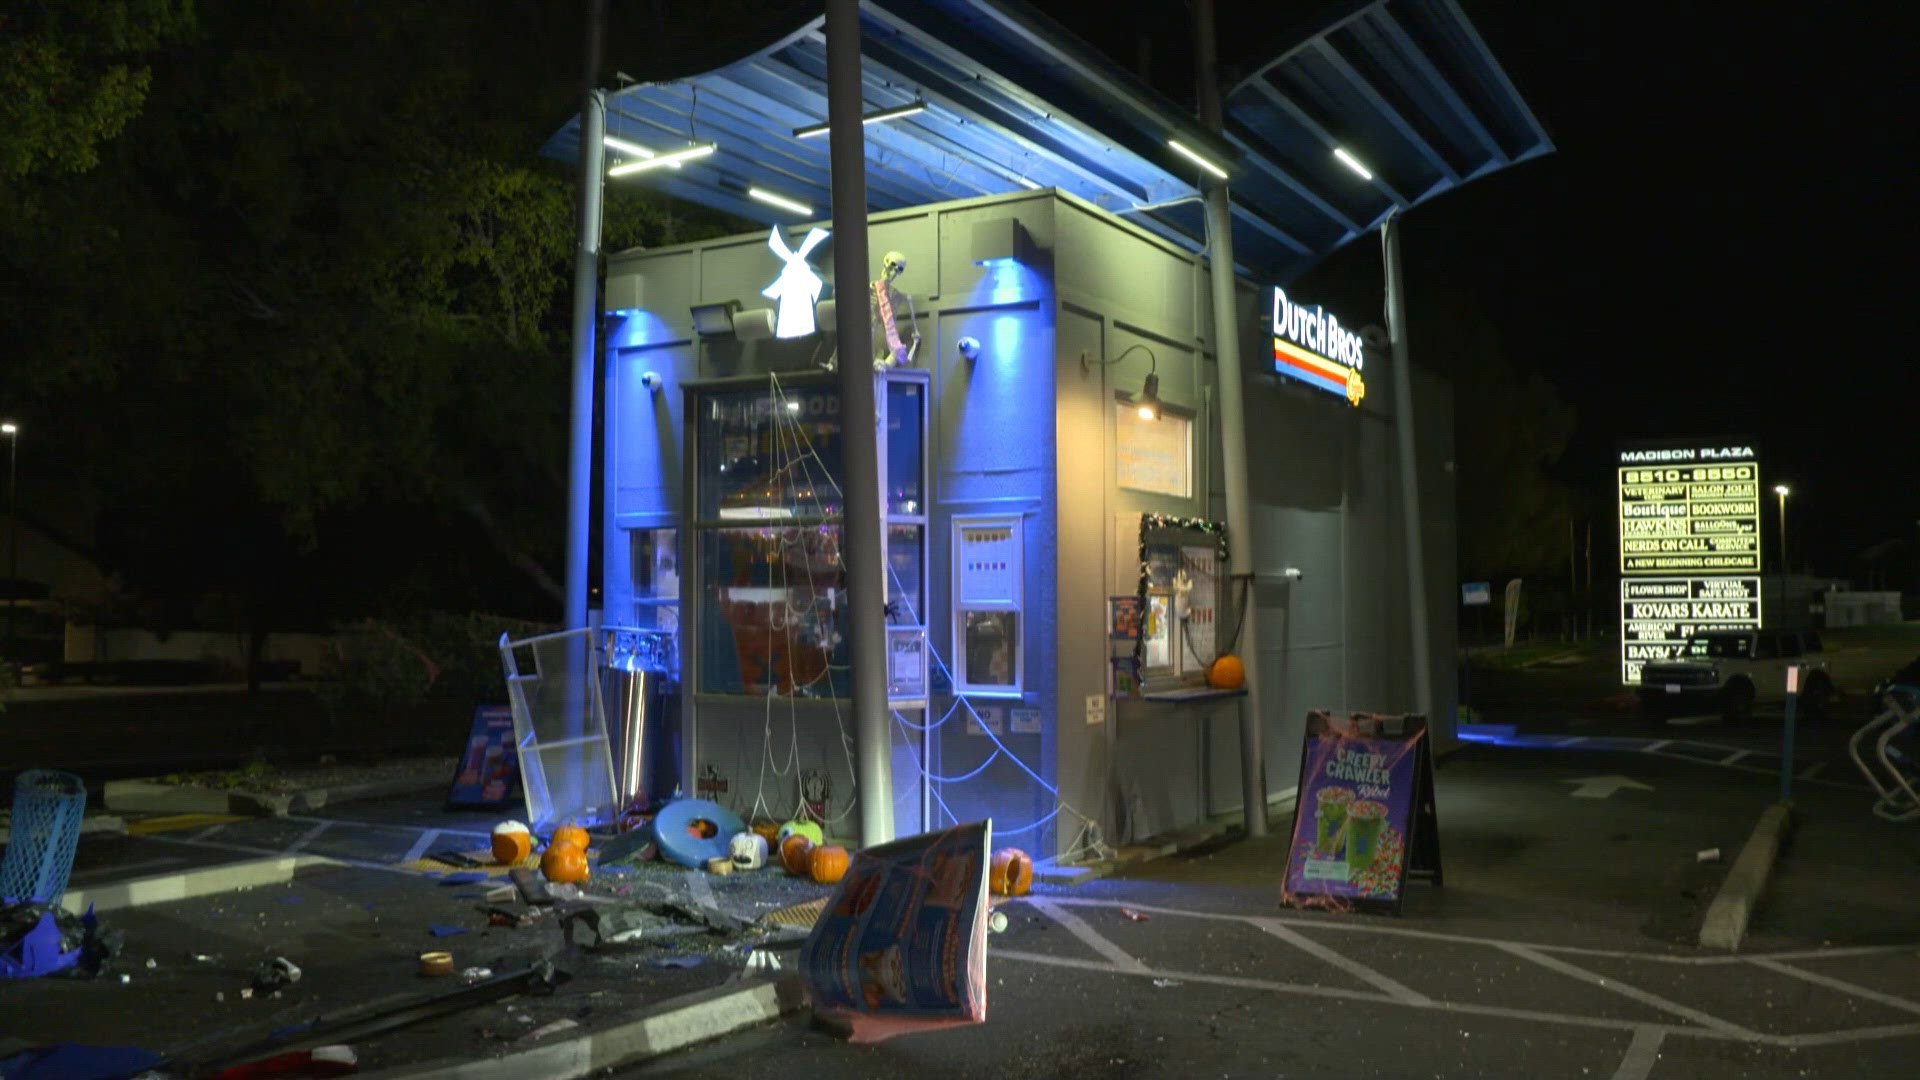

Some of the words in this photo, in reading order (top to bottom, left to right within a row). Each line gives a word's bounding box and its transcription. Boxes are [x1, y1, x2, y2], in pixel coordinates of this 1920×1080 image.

[1327, 313, 1363, 370] BROS
[1621, 449, 1695, 461] MADISON
[1700, 447, 1753, 458] PLAZA
[1624, 486, 1684, 496] VETERINARY
[1691, 485, 1724, 495] SALON
[1623, 503, 1686, 518] Boutique
[1692, 503, 1754, 515] BOOKWORM
[1624, 520, 1687, 531] HAWKINS
[1624, 539, 1660, 551] NERDS
[1661, 539, 1678, 551] ON
[1678, 538, 1708, 551] CALL
[1627, 560, 1634, 568] A
[1635, 559, 1655, 567] NEW
[1656, 558, 1703, 567] BEGINNING
[1704, 557, 1754, 566] CHILDCARE
[1703, 580, 1744, 588] VIRTUAL
[1630, 585, 1664, 595] FLOWER
[1665, 585, 1687, 595] SHOP
[1699, 589, 1722, 598] SAFE
[1724, 588, 1750, 598] SHOT
[1632, 603, 1690, 618] KOVARS
[1692, 603, 1750, 618] KARATE
[1628, 622, 1676, 632] AMERICAN
[1638, 631, 1666, 640] RIVER
[1336, 747, 1388, 769] CREEPY
[1326, 759, 1390, 785] CRAWLER
